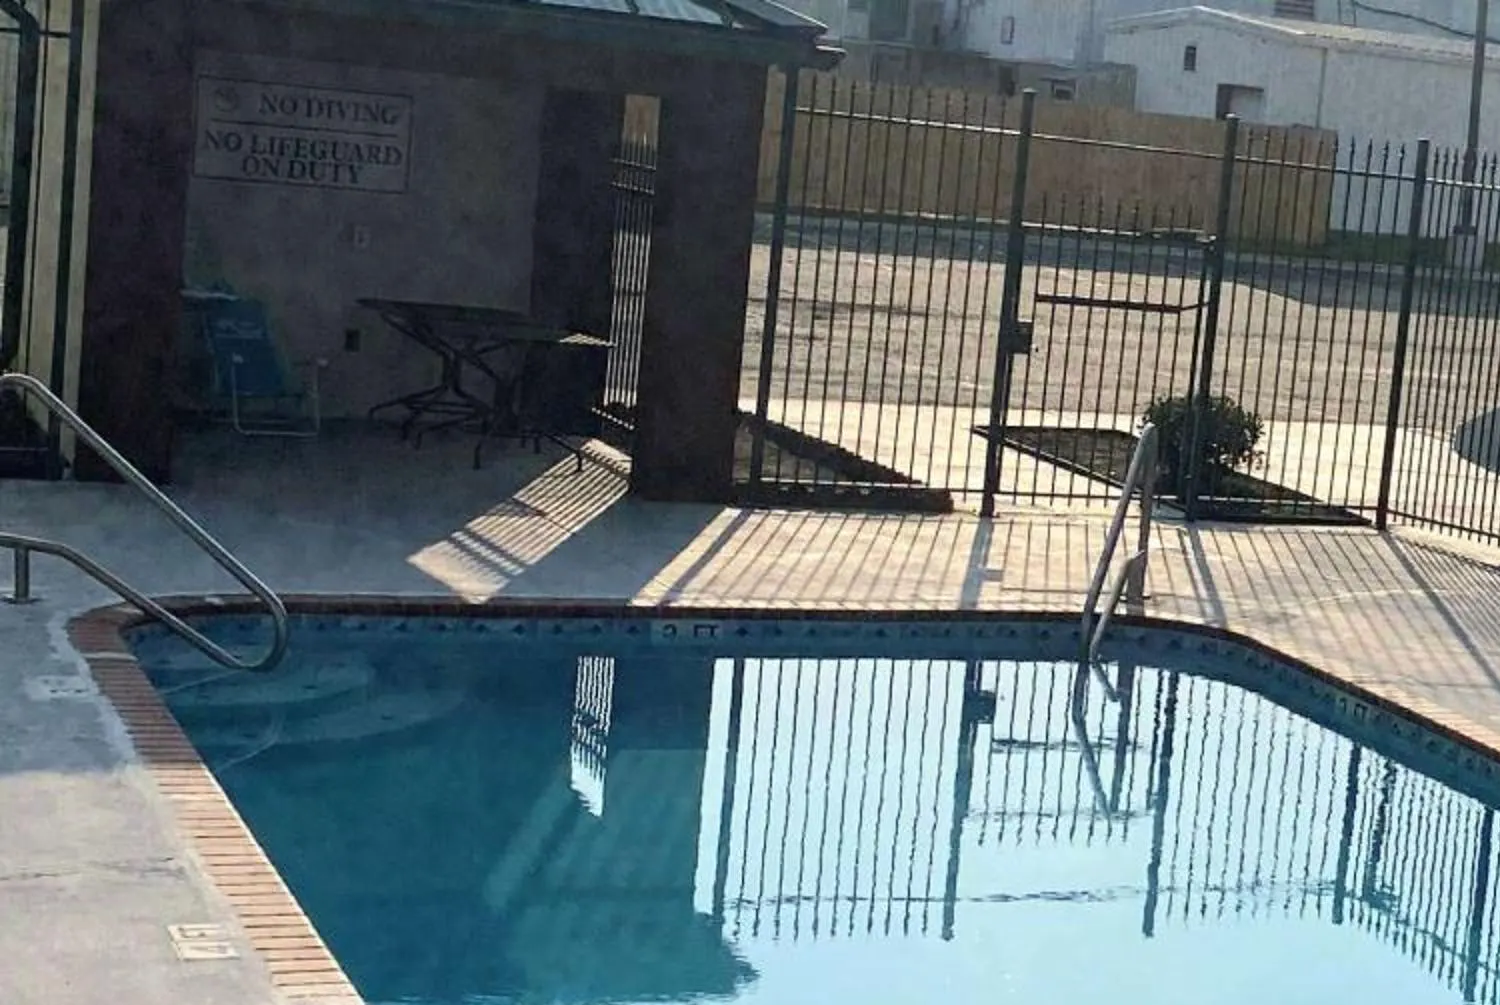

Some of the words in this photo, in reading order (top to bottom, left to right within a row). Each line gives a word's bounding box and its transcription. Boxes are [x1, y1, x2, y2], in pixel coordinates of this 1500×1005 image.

[259, 92, 298, 115] NO
[304, 97, 399, 125] DIVING
[204, 129, 242, 152] NO
[250, 134, 403, 165] LIFEGUARD
[242, 156, 280, 178] ON
[287, 159, 363, 184] DUTY
